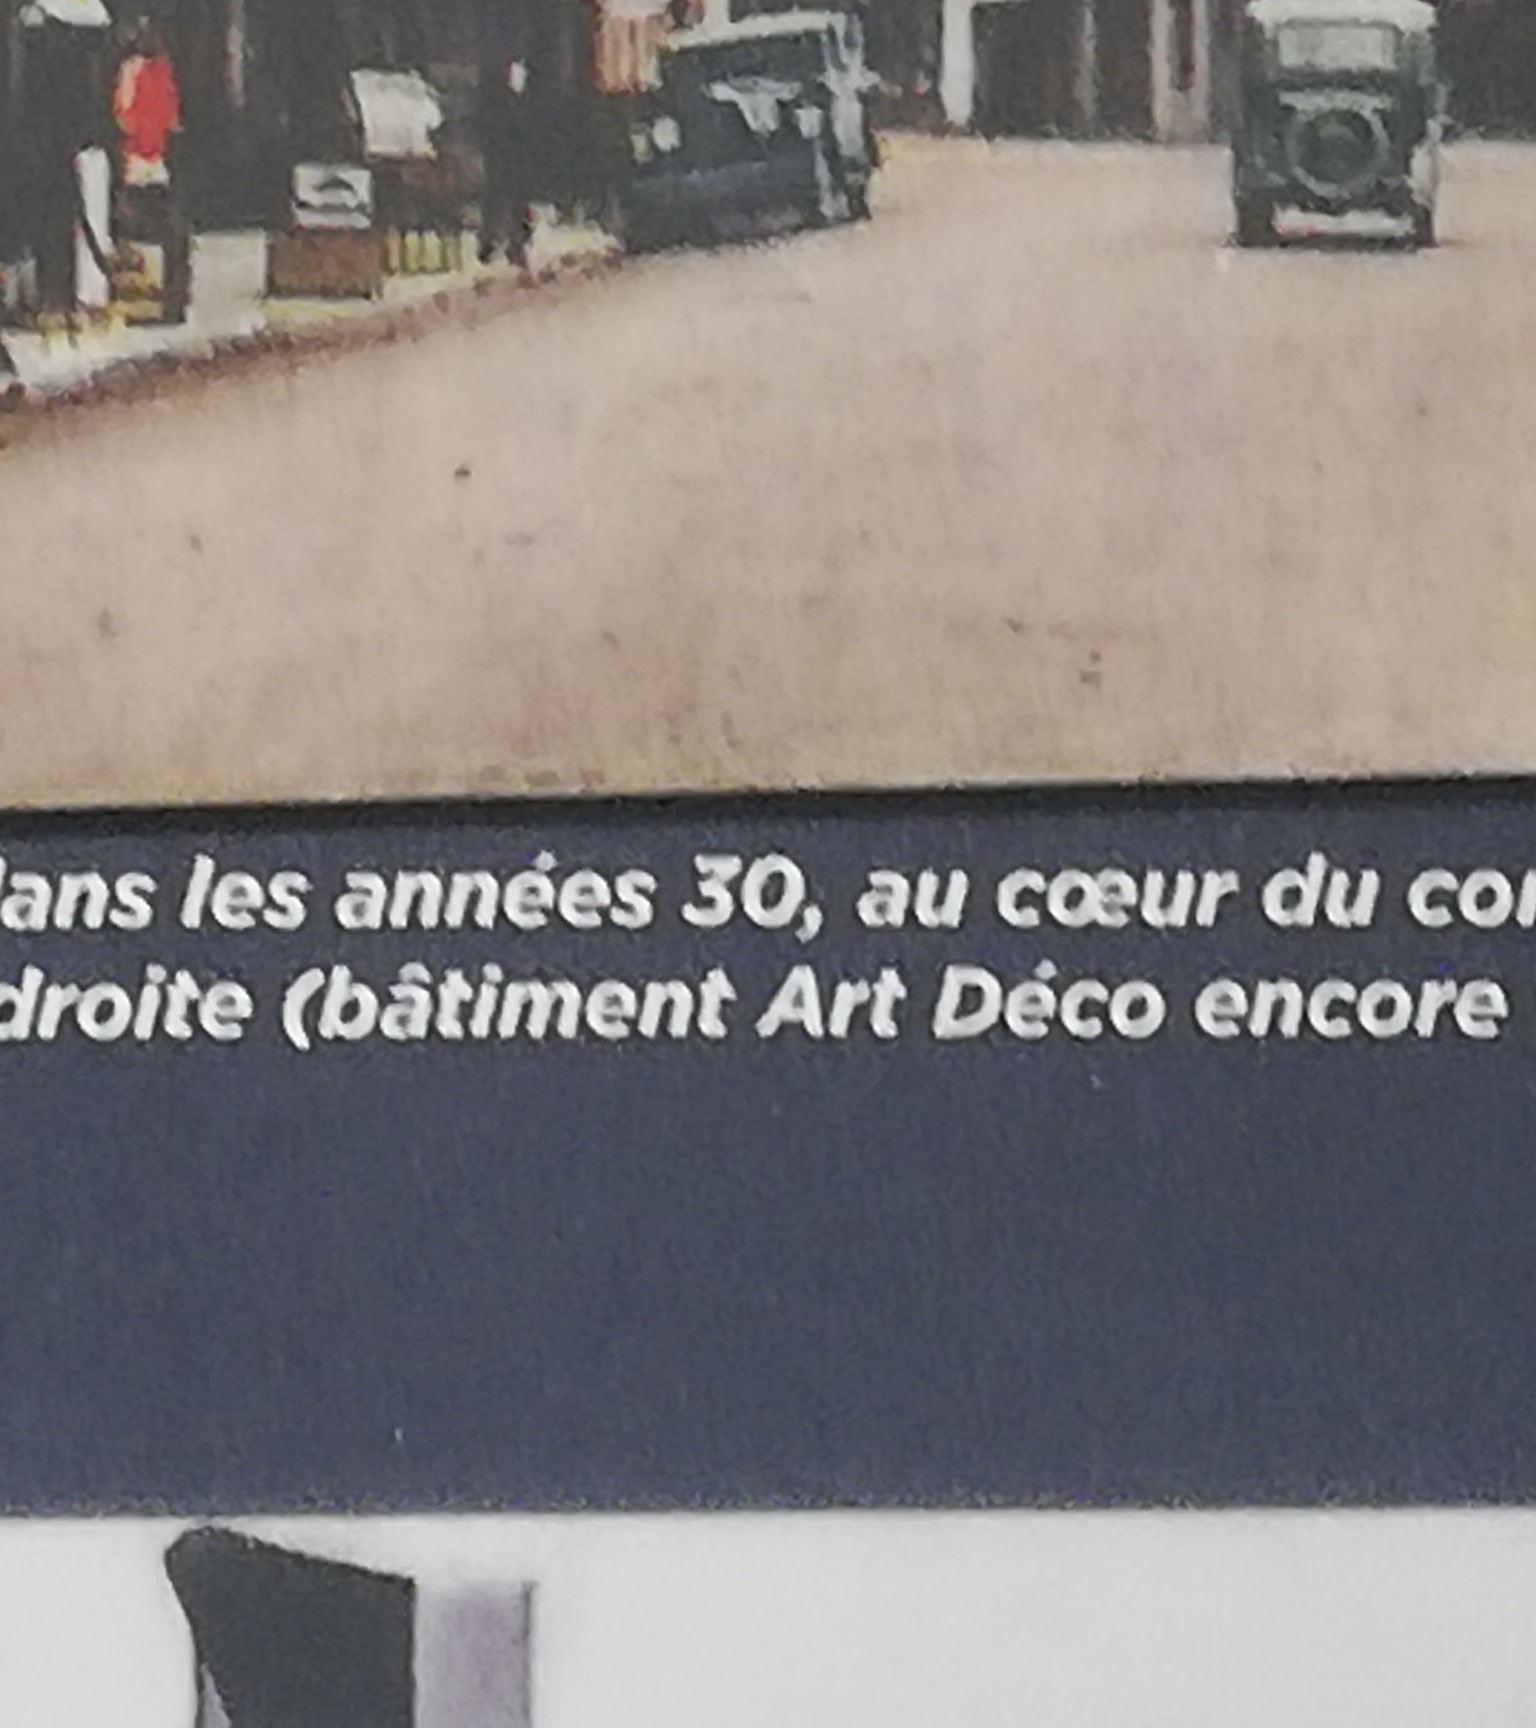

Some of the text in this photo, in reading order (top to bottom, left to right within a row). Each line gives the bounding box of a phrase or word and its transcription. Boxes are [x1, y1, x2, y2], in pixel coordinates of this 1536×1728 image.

[180, 853, 310, 930] les
[334, 849, 658, 930] années
[681, 852, 824, 943] 30,
[856, 868, 969, 929] au
[996, 868, 1240, 929] cœur
[1261, 851, 1380, 929] du
[282, 961, 737, 1051] (bâtiment
[755, 964, 908, 1039] Art
[932, 959, 1166, 1039] Déco
[1194, 978, 1509, 1039] encore
